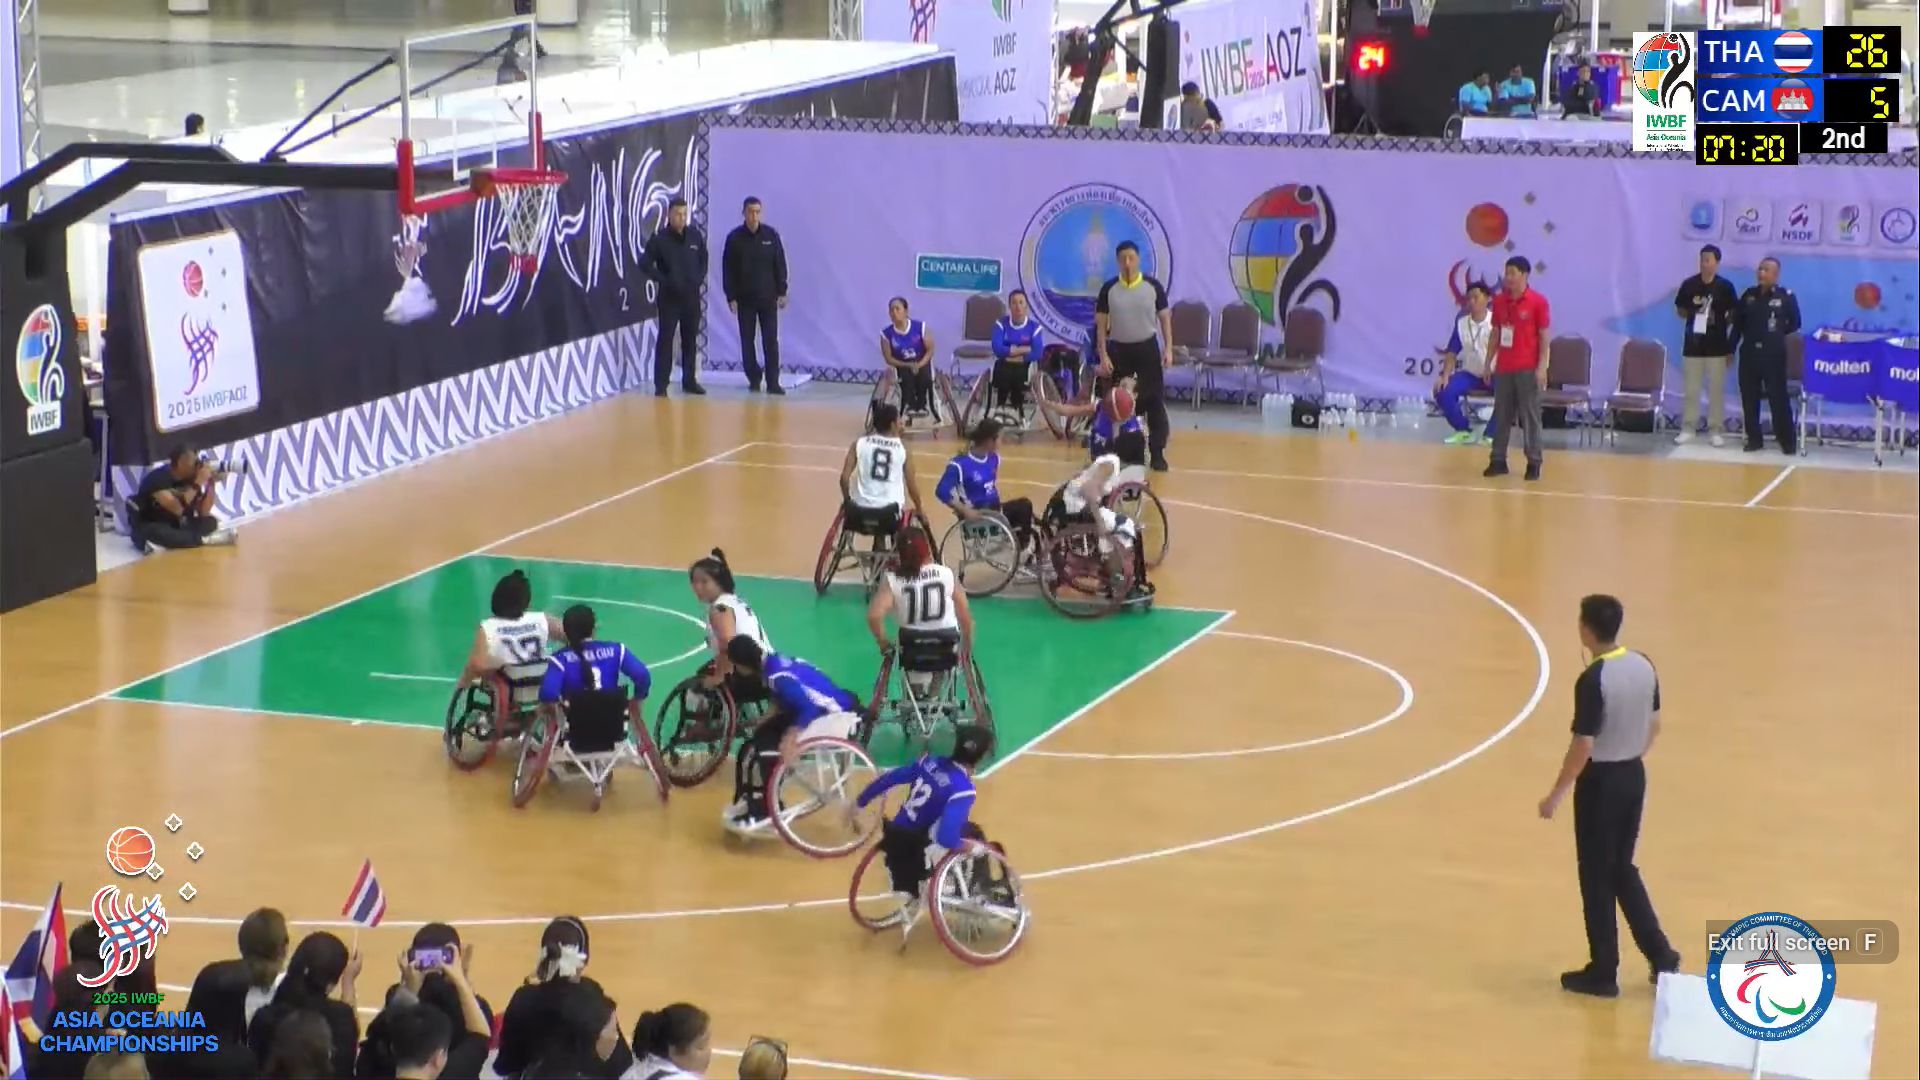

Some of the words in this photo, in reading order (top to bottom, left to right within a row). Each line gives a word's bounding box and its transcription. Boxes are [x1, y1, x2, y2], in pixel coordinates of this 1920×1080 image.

[993, 32, 1017, 57] IWBF
[1201, 38, 1253, 99] IWBF
[1265, 27, 1306, 84] AOZ
[1358, 46, 1384, 70] 24
[994, 68, 1017, 95] AOZ
[1782, 230, 1814, 241] NSDF
[921, 260, 971, 273] CENTARA
[1813, 358, 1871, 374] molten
[168, 396, 201, 419] 2025
[30, 412, 58, 432] IWBF
[872, 447, 891, 482] 8
[901, 581, 946, 625] 10
[903, 776, 933, 822] 12
